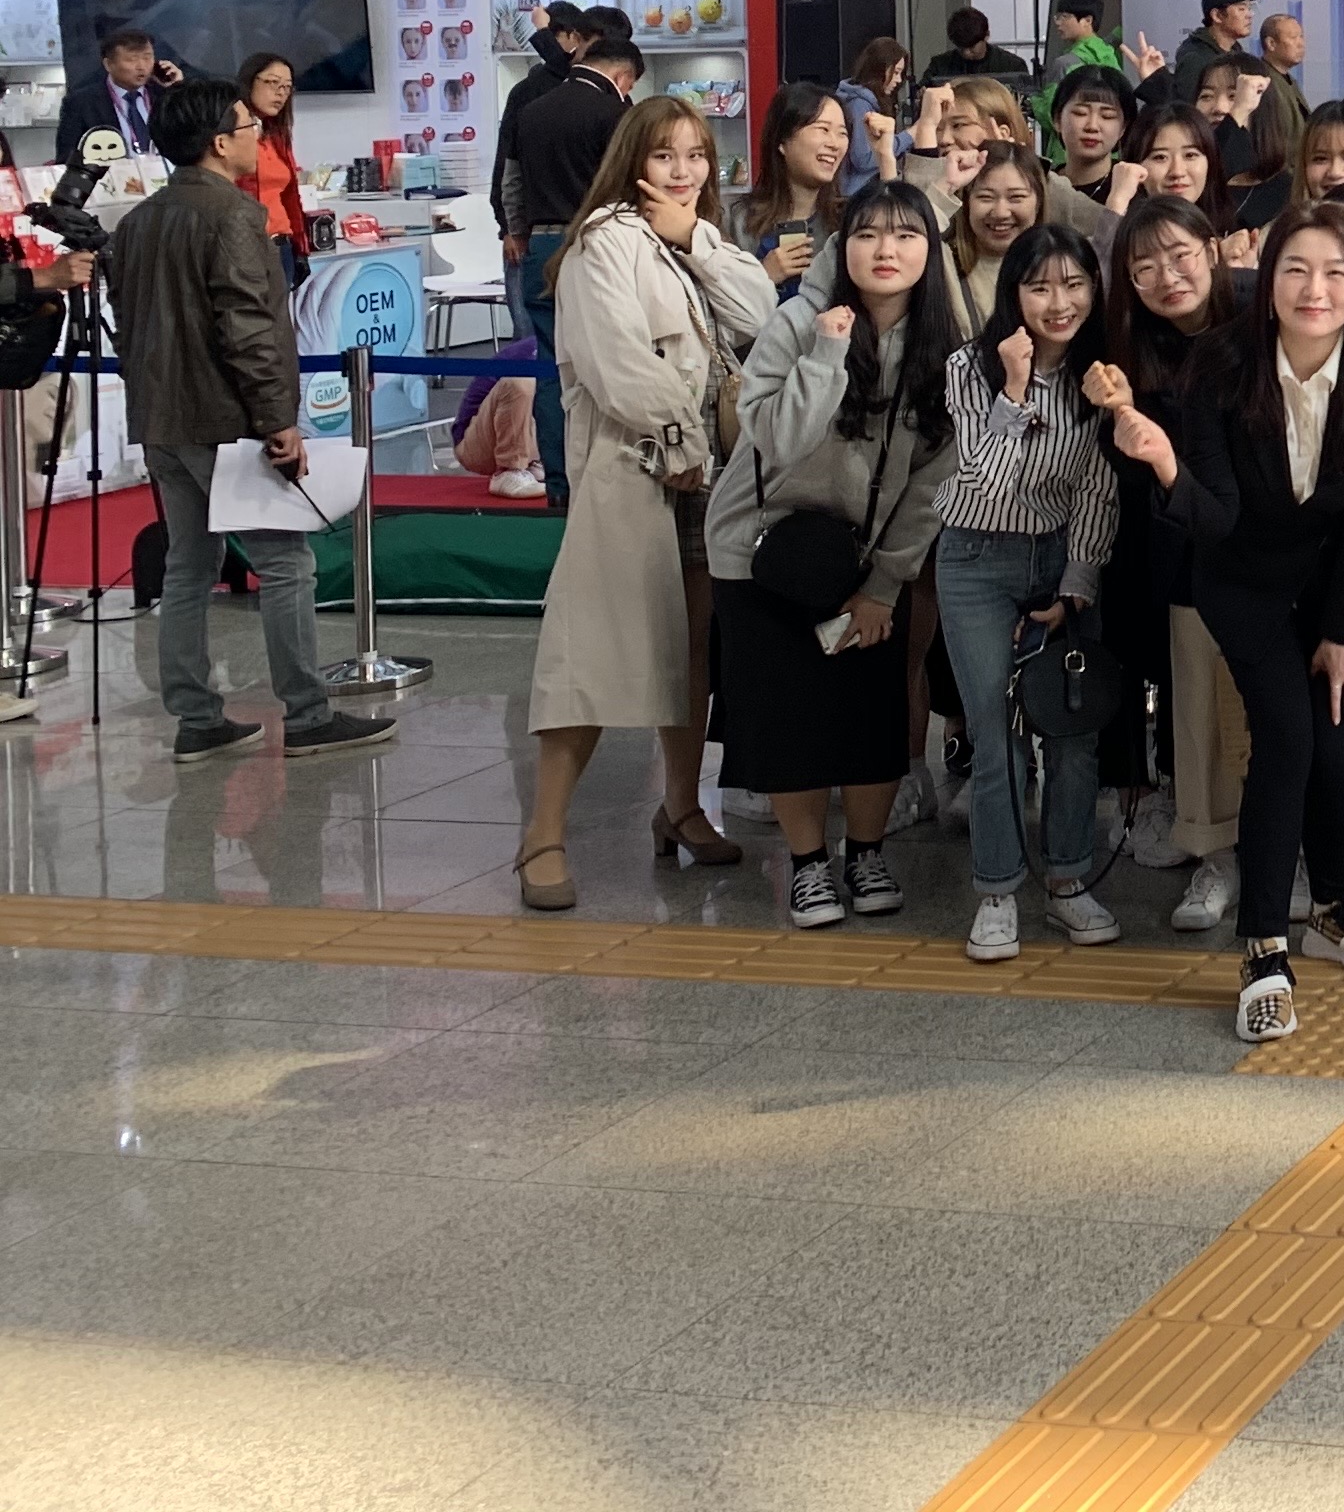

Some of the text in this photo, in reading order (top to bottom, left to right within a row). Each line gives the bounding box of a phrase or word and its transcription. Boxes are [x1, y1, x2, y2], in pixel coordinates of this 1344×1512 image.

[356, 289, 394, 314] OEM
[373, 314, 380, 324] &
[356, 324, 396, 347] ODM
[315, 386, 342, 403] GMP
